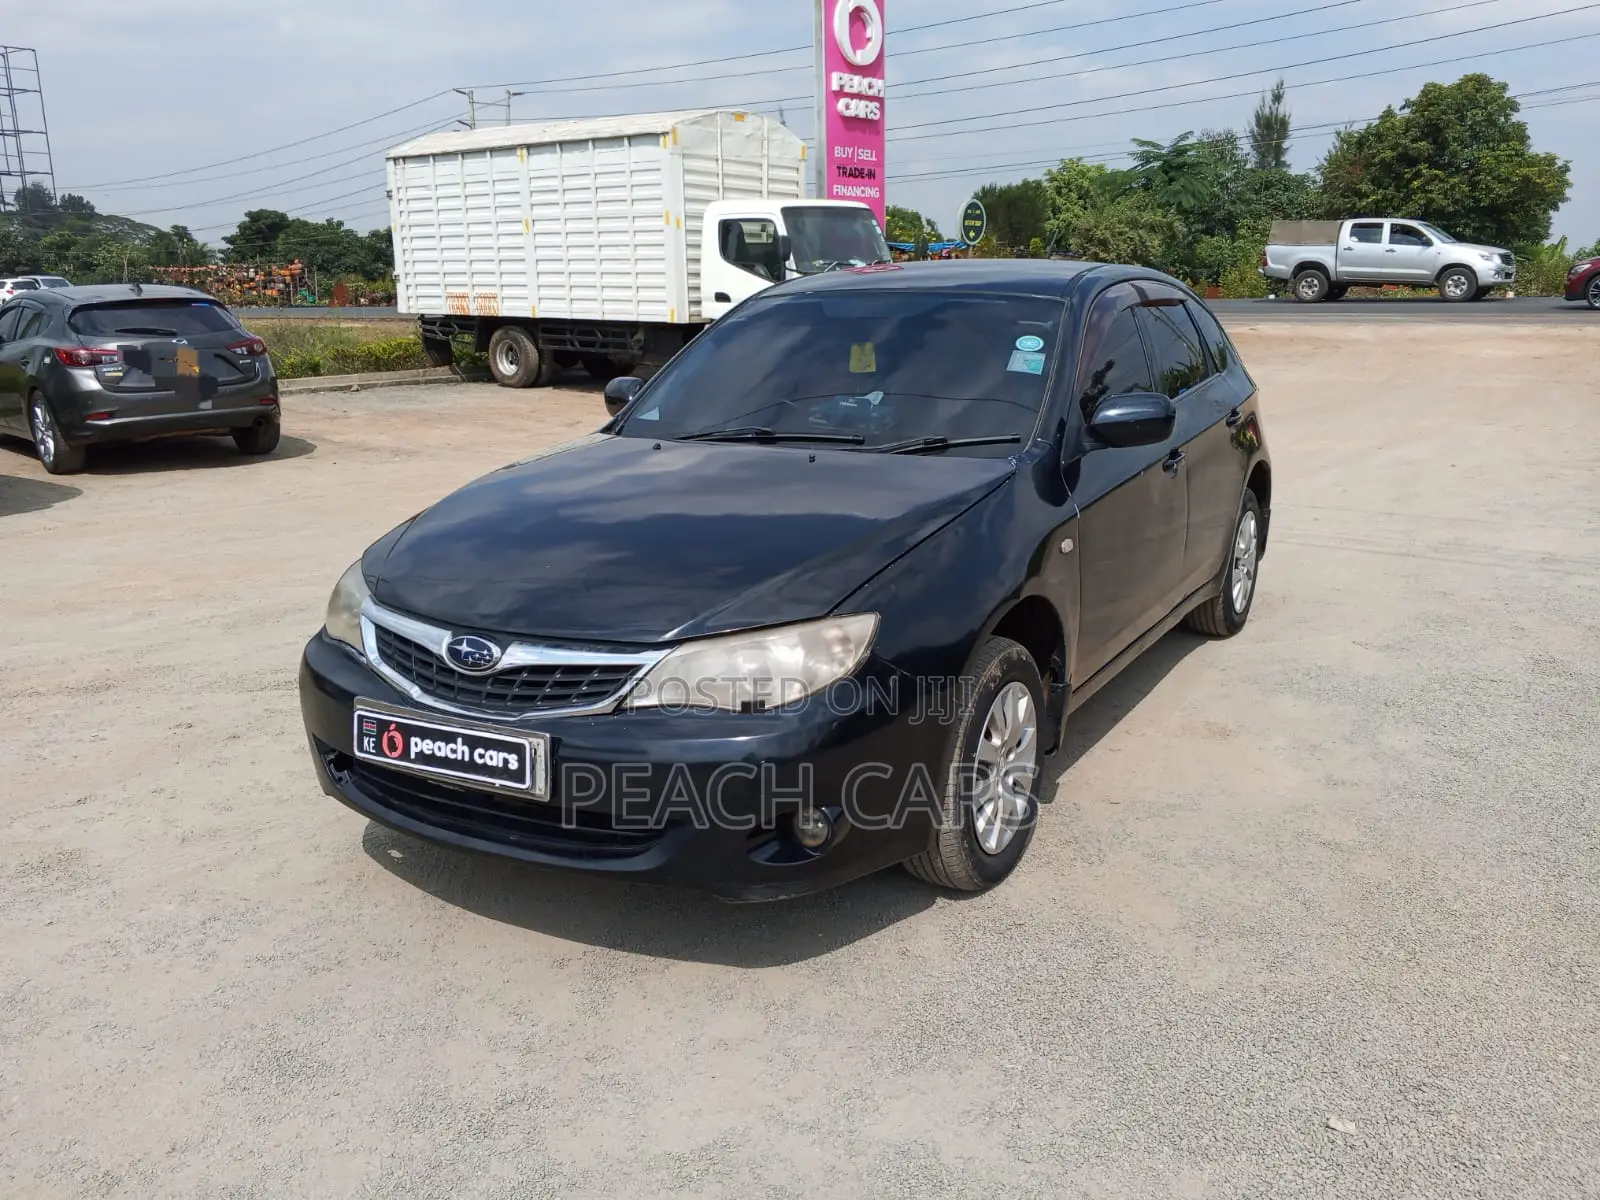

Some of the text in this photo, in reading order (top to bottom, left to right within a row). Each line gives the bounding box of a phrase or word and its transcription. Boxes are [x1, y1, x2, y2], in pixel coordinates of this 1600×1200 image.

[831, 72, 884, 97] PEACH
[837, 98, 880, 120] CARS
[836, 165, 875, 180] TRADE-IN
[833, 184, 880, 198] FINANCING
[363, 736, 377, 753] KE
[410, 736, 519, 770] peach cars
